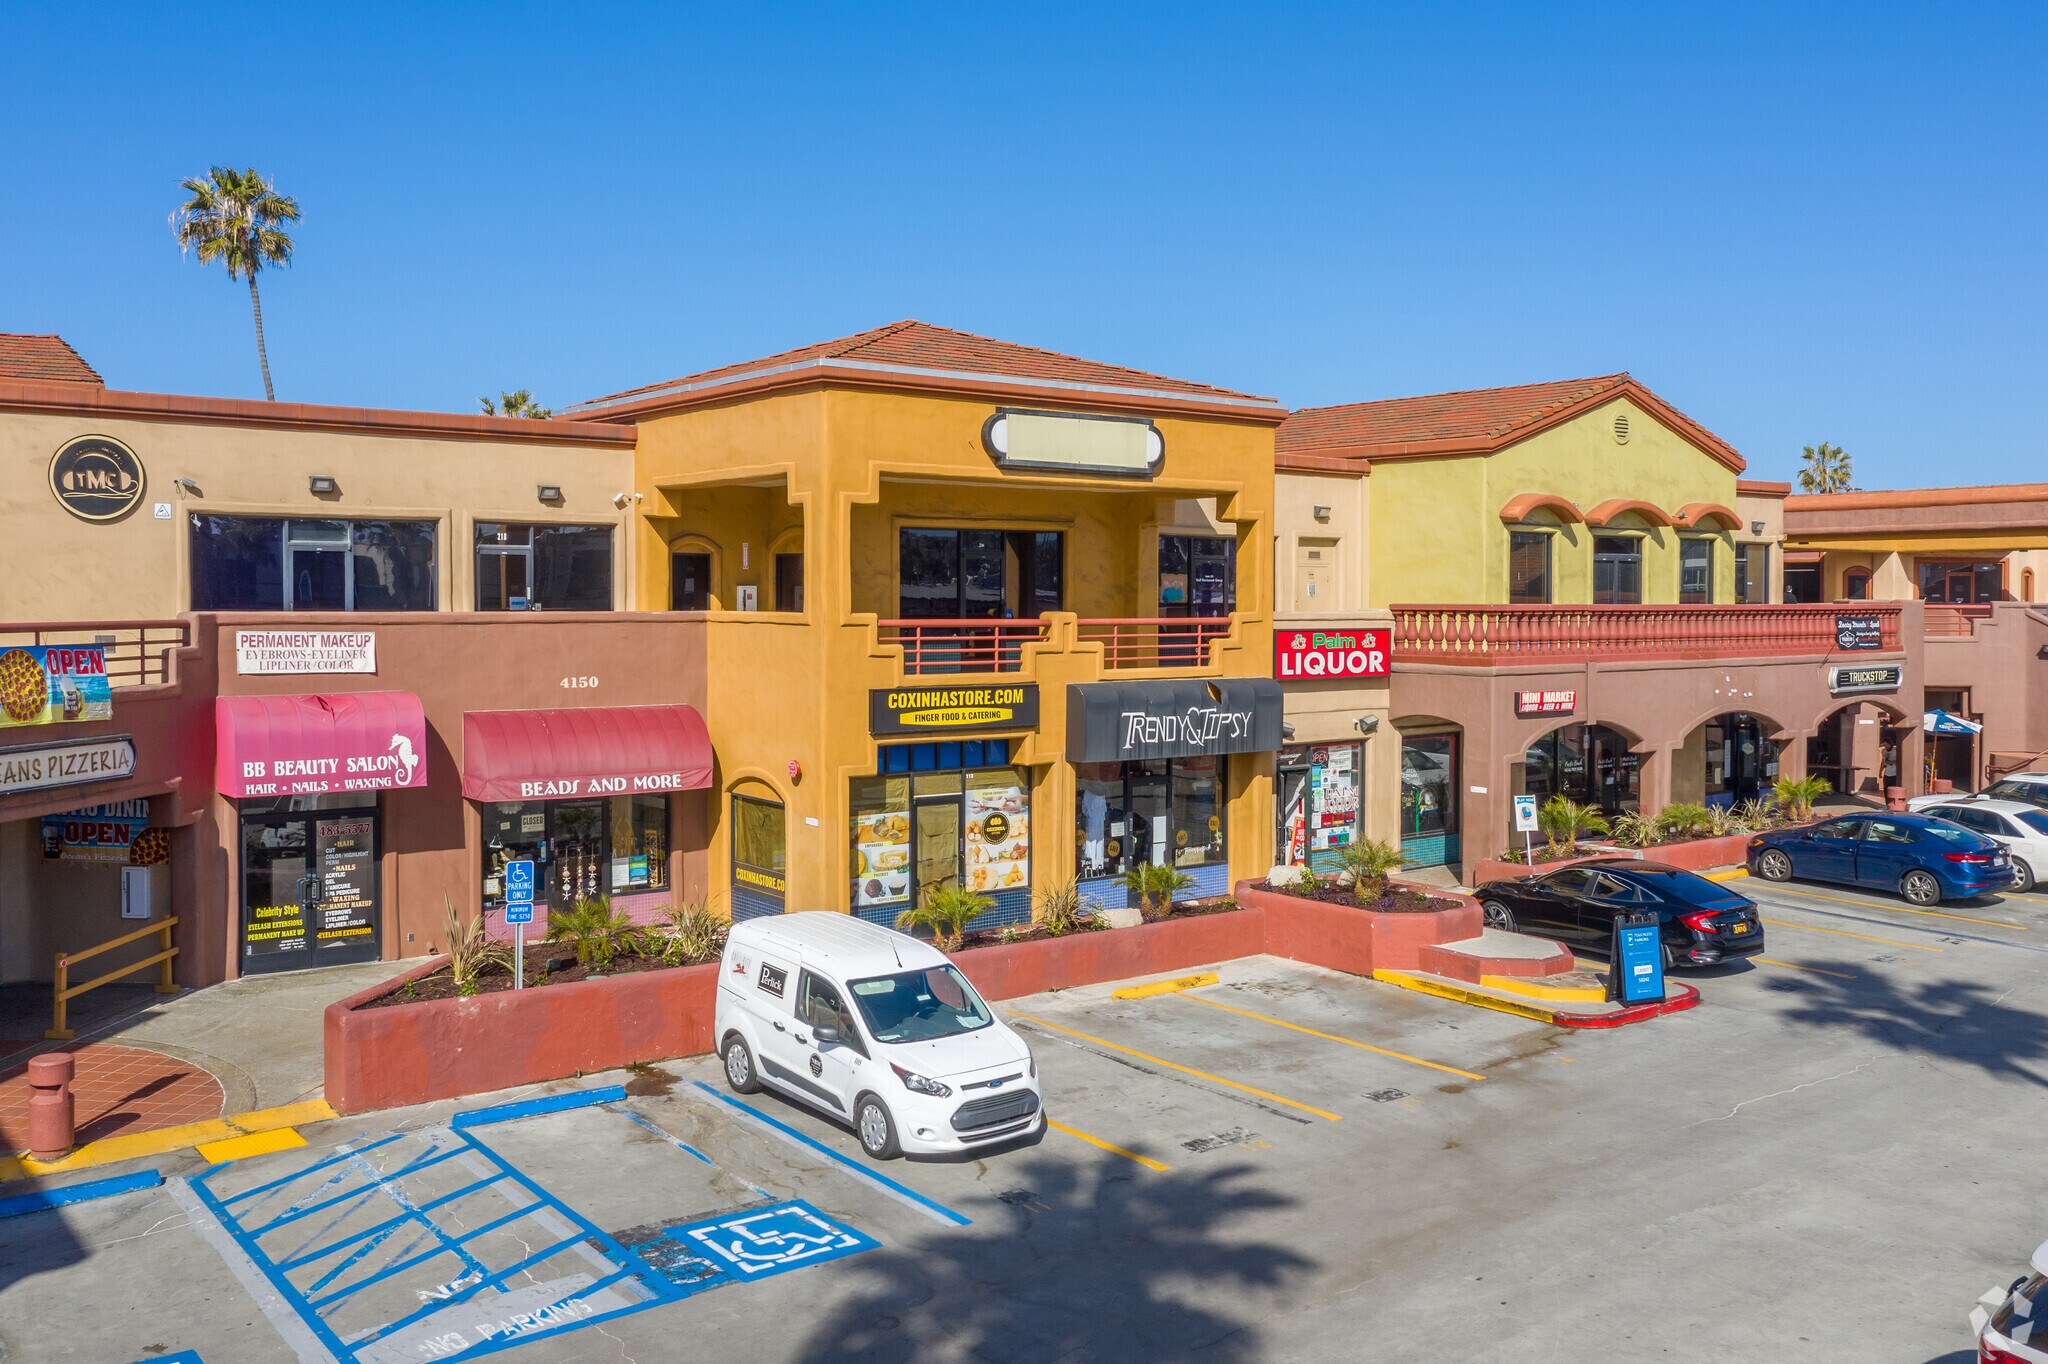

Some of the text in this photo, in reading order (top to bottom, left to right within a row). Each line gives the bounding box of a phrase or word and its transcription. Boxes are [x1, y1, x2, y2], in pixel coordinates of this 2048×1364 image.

[76, 469, 116, 489] TMC
[240, 633, 371, 648] PERMANENT MAKEUP
[1312, 632, 1356, 649] Palm
[45, 648, 105, 675] OPEN
[245, 650, 367, 660] EYEBROWS-EYELINER
[1281, 650, 1385, 676] LIQUOR
[559, 675, 599, 689] 4150
[1848, 670, 1888, 683] TRUCKSTOP
[887, 688, 1024, 709] COXINHASTORE.COM
[1521, 691, 1576, 704] MINI MARKET
[914, 710, 1002, 723] FINGER FOOD & CATERING
[48, 748, 130, 778] PIZZERIA
[243, 755, 400, 778] BB BEAUTY SALON
[246, 777, 392, 795] HAIR NAILS WAXING
[521, 774, 682, 797] BEADS AND MORE
[522, 816, 544, 826] CLOSED
[64, 821, 130, 846] OPEN
[336, 839, 355, 847] HAIR
[1109, 844, 1119, 853] SALE
[334, 863, 357, 872] NAILS
[325, 871, 346, 879] ACRYLIC
[508, 881, 532, 891] PARKING
[332, 894, 360, 903] WAXING
[512, 890, 527, 900] ONLY
[350, 900, 373, 908] MAKEUP
[256, 904, 300, 918] Celebrity Style
[325, 908, 352, 917] EYEBROWS
[518, 912, 531, 920] $250
[247, 918, 304, 932] EYELASH EXTENSIONS
[325, 915, 349, 923] EYELINER
[247, 931, 281, 942] PERMANENT
[280, 929, 297, 938] MAKE
[760, 967, 783, 991] Perlick
[474, 1298, 593, 1341] PARKING
